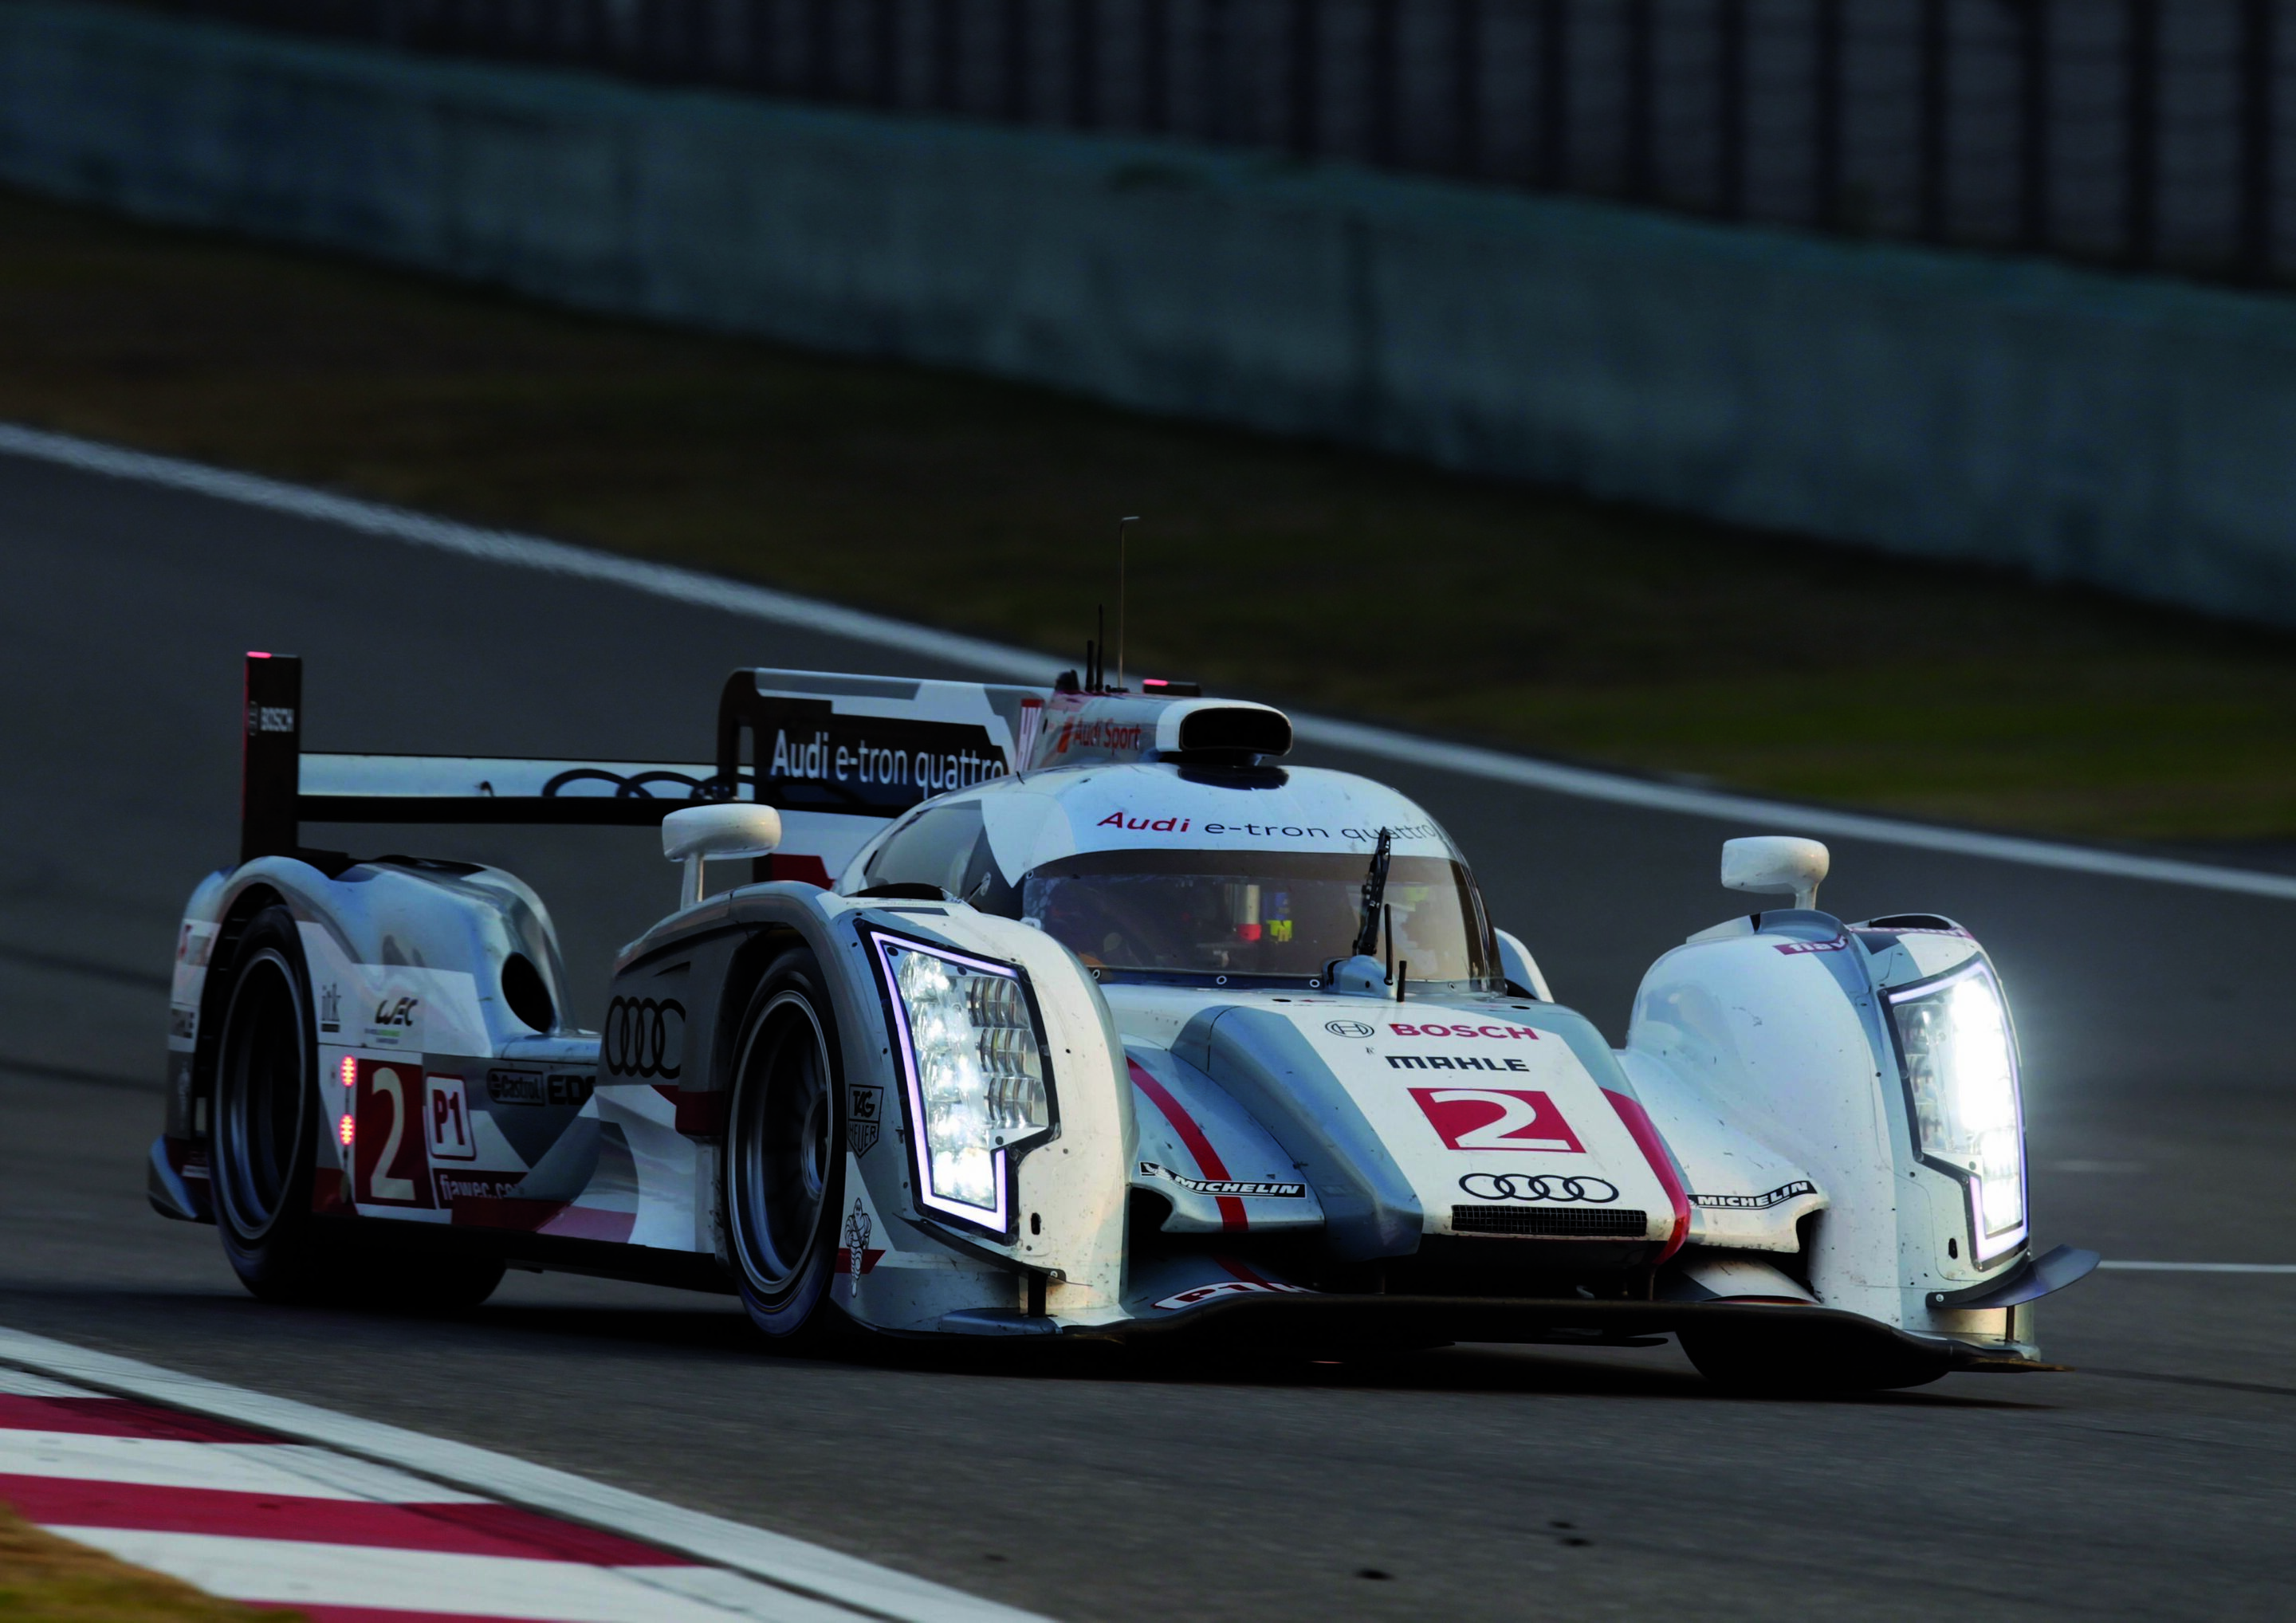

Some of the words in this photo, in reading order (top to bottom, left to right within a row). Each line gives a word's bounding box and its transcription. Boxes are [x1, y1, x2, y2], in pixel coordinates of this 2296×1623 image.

[260, 706, 295, 733] BOSCH
[1074, 718, 1101, 748] Audi
[1103, 718, 1142, 756] Sport
[770, 729, 829, 780] Audi
[835, 739, 908, 785] e-tron
[914, 748, 1005, 800] quattro
[1097, 812, 1189, 833] Audi
[1205, 822, 1329, 839] e-tron
[375, 996, 419, 1026] WEC
[1389, 1024, 1539, 1040] BOSCH
[1385, 1055, 1530, 1071] MAHLE
[501, 1075, 541, 1099] Castrol
[433, 1089, 466, 1146] P1
[853, 1091, 875, 1118] TAG
[1429, 1089, 1571, 1150] 2
[370, 1067, 417, 1201] 2
[850, 1124, 876, 1152] HEUER
[1174, 1175, 1299, 1194] MICHELIN
[1697, 1181, 1809, 1207] MICHELIN
[1174, 1284, 1255, 1303] P1
